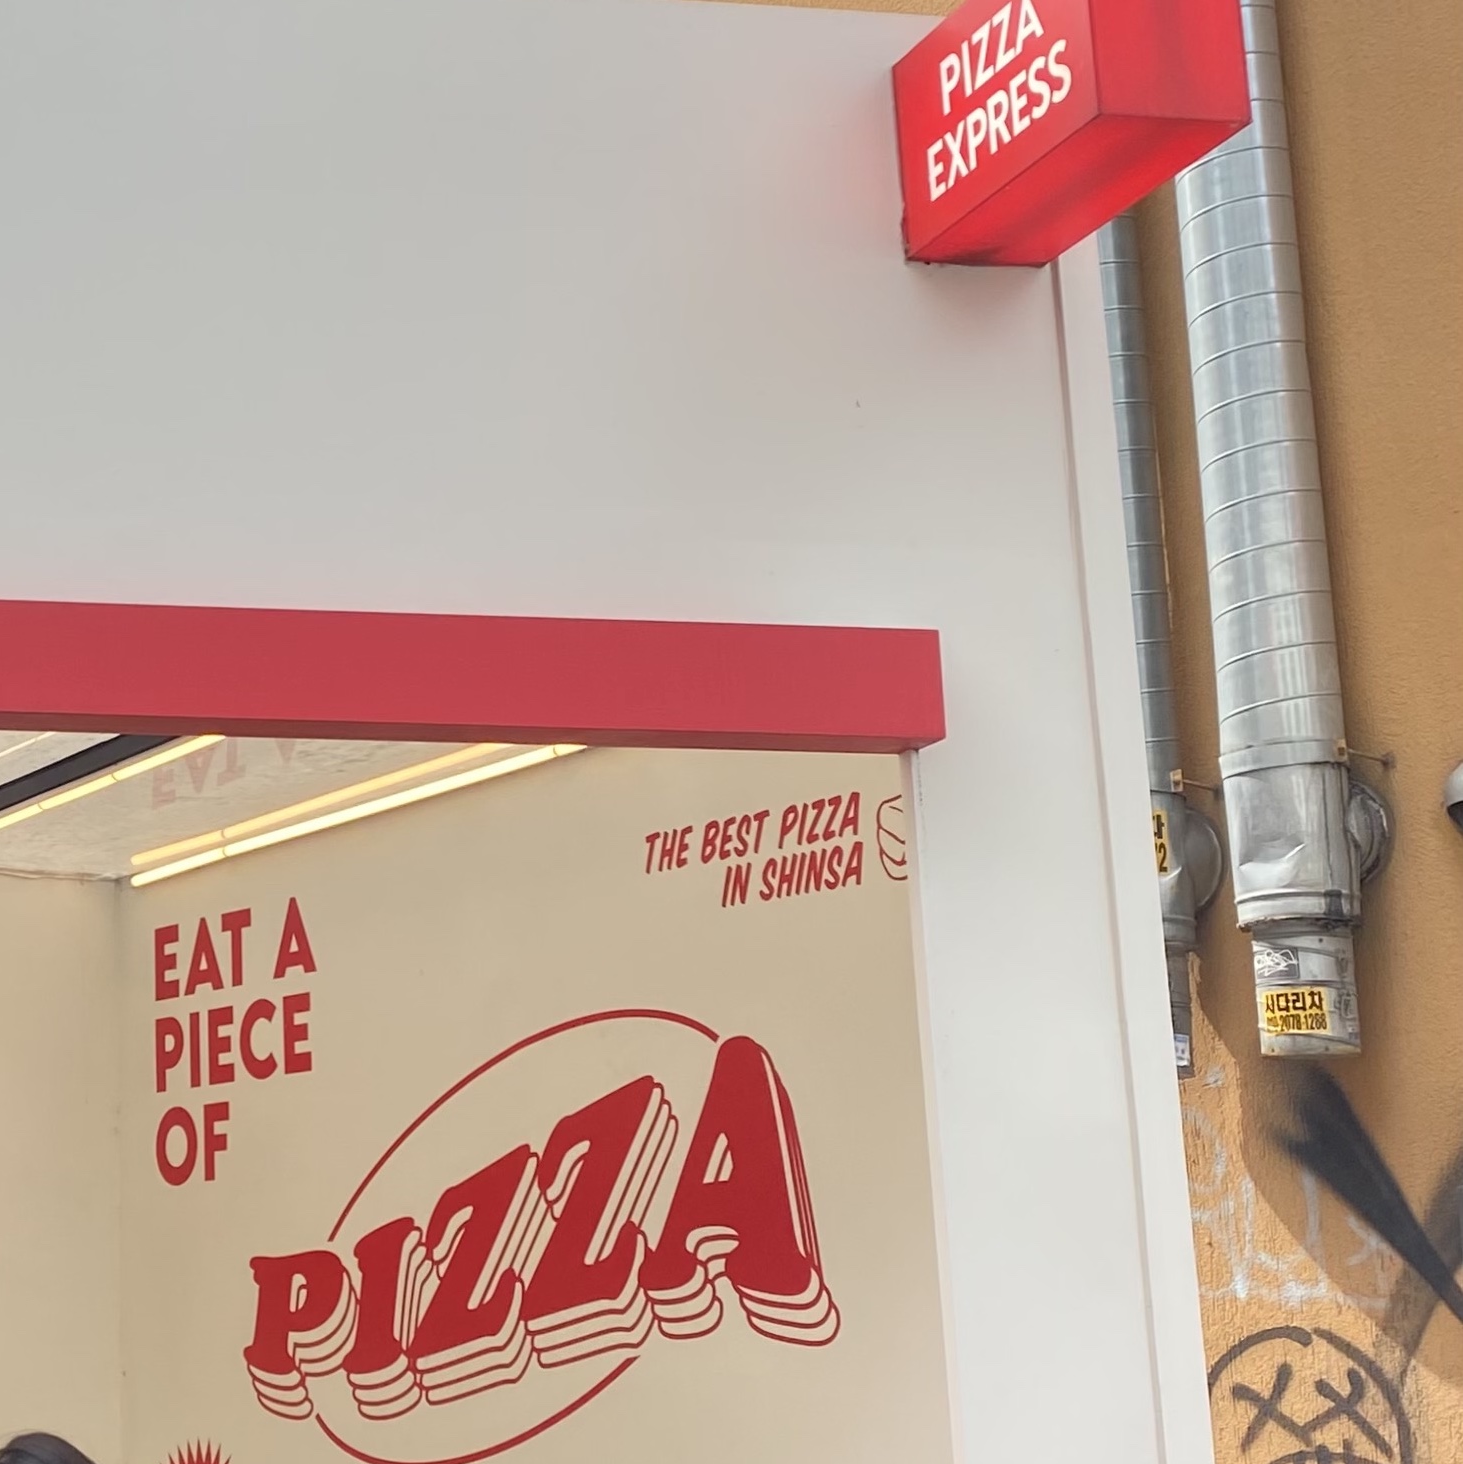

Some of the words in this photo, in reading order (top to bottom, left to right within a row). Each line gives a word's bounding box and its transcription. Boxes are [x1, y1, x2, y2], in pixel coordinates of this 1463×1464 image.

[939, 0, 1045, 117] PIZZA
[926, 39, 1072, 202] EXPRESS
[645, 825, 693, 875] THE
[700, 809, 770, 864] BEST
[778, 791, 861, 849] PIZZA
[721, 862, 752, 908] IN
[758, 841, 864, 901] SHINSA
[154, 907, 252, 1002] EAT
[273, 896, 317, 979] A
[155, 991, 313, 1093] PIECE
[155, 1101, 230, 1187] OF
[244, 1035, 841, 1421] PIZZA
